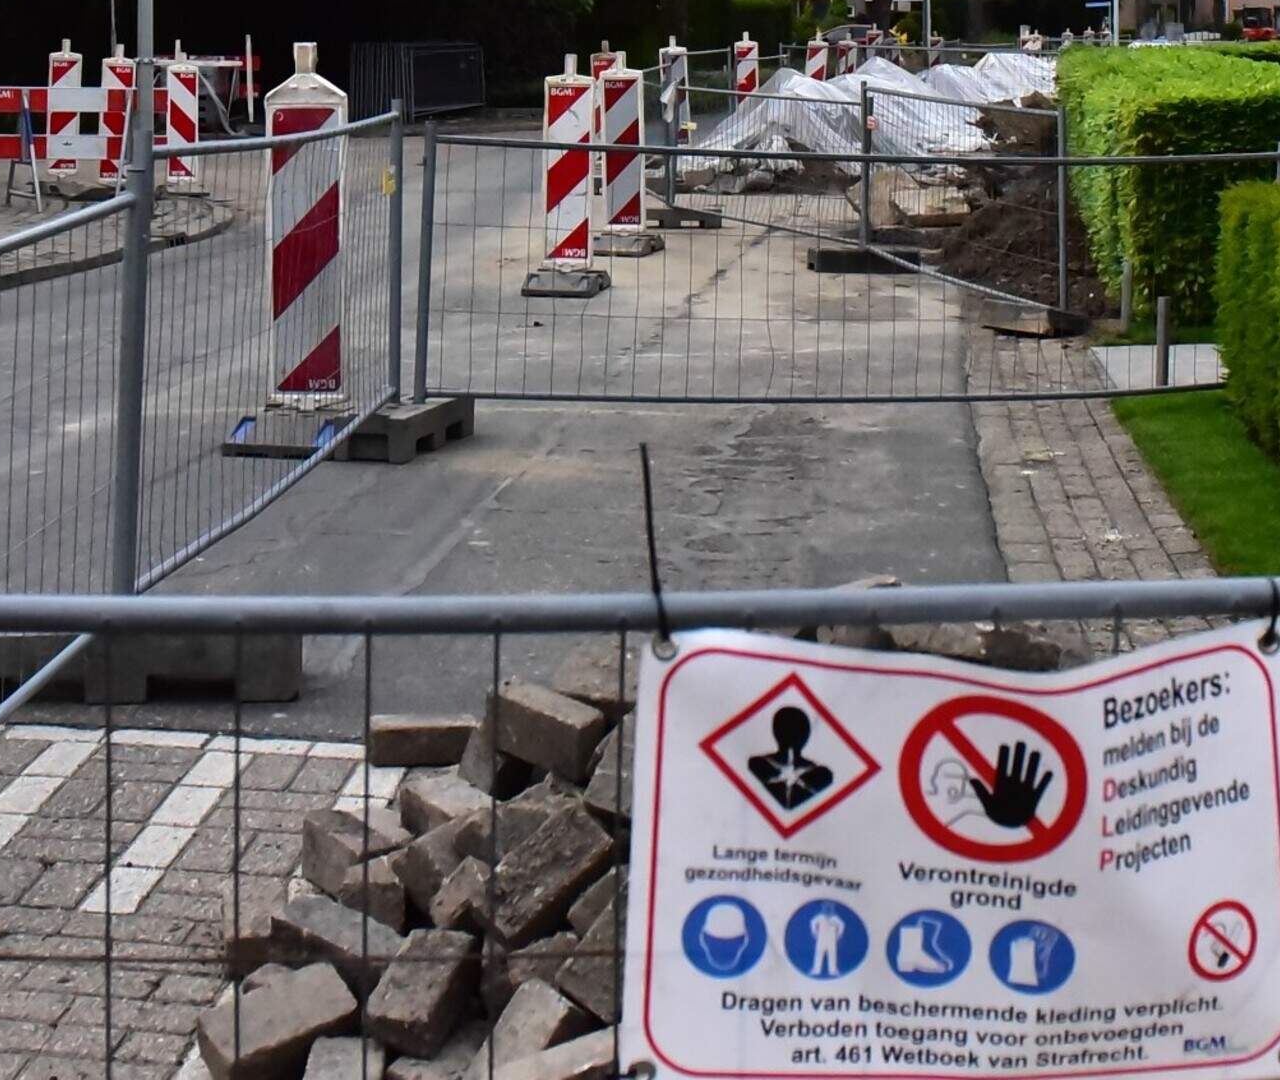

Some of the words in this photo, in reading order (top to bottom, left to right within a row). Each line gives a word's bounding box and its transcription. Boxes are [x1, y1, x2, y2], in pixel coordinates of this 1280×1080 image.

[1103, 671, 1231, 730] Bezoekers:
[1103, 729, 1166, 766] melden
[1170, 717, 1192, 747] bij
[1197, 713, 1220, 737] de
[1102, 756, 1197, 802] Deskundig
[1101, 779, 1251, 837] Leidinggevende
[712, 845, 769, 864] Lange
[773, 848, 838, 869] termijn
[1099, 833, 1192, 872] Projecten
[684, 866, 863, 891] gezondheidsgevaar
[898, 861, 1077, 899] Verontreinigde
[950, 889, 1022, 910] grond
[721, 992, 803, 1016] Dragen
[810, 996, 851, 1011] van
[858, 994, 1027, 1024] beschermende
[1036, 1005, 1116, 1026] kleding
[1124, 996, 1224, 1019] verplicht.
[760, 1018, 868, 1038] Verboden
[875, 1021, 968, 1047] toegang
[975, 1029, 1027, 1046] voor
[1035, 1022, 1184, 1046] onbevoegden
[1183, 1036, 1226, 1051] BGM
[791, 1047, 826, 1064] art.
[834, 1045, 872, 1064] 461
[881, 1045, 980, 1067] Wetboek
[988, 1055, 1028, 1069] van
[1036, 1046, 1149, 1068] Strafrecht.
